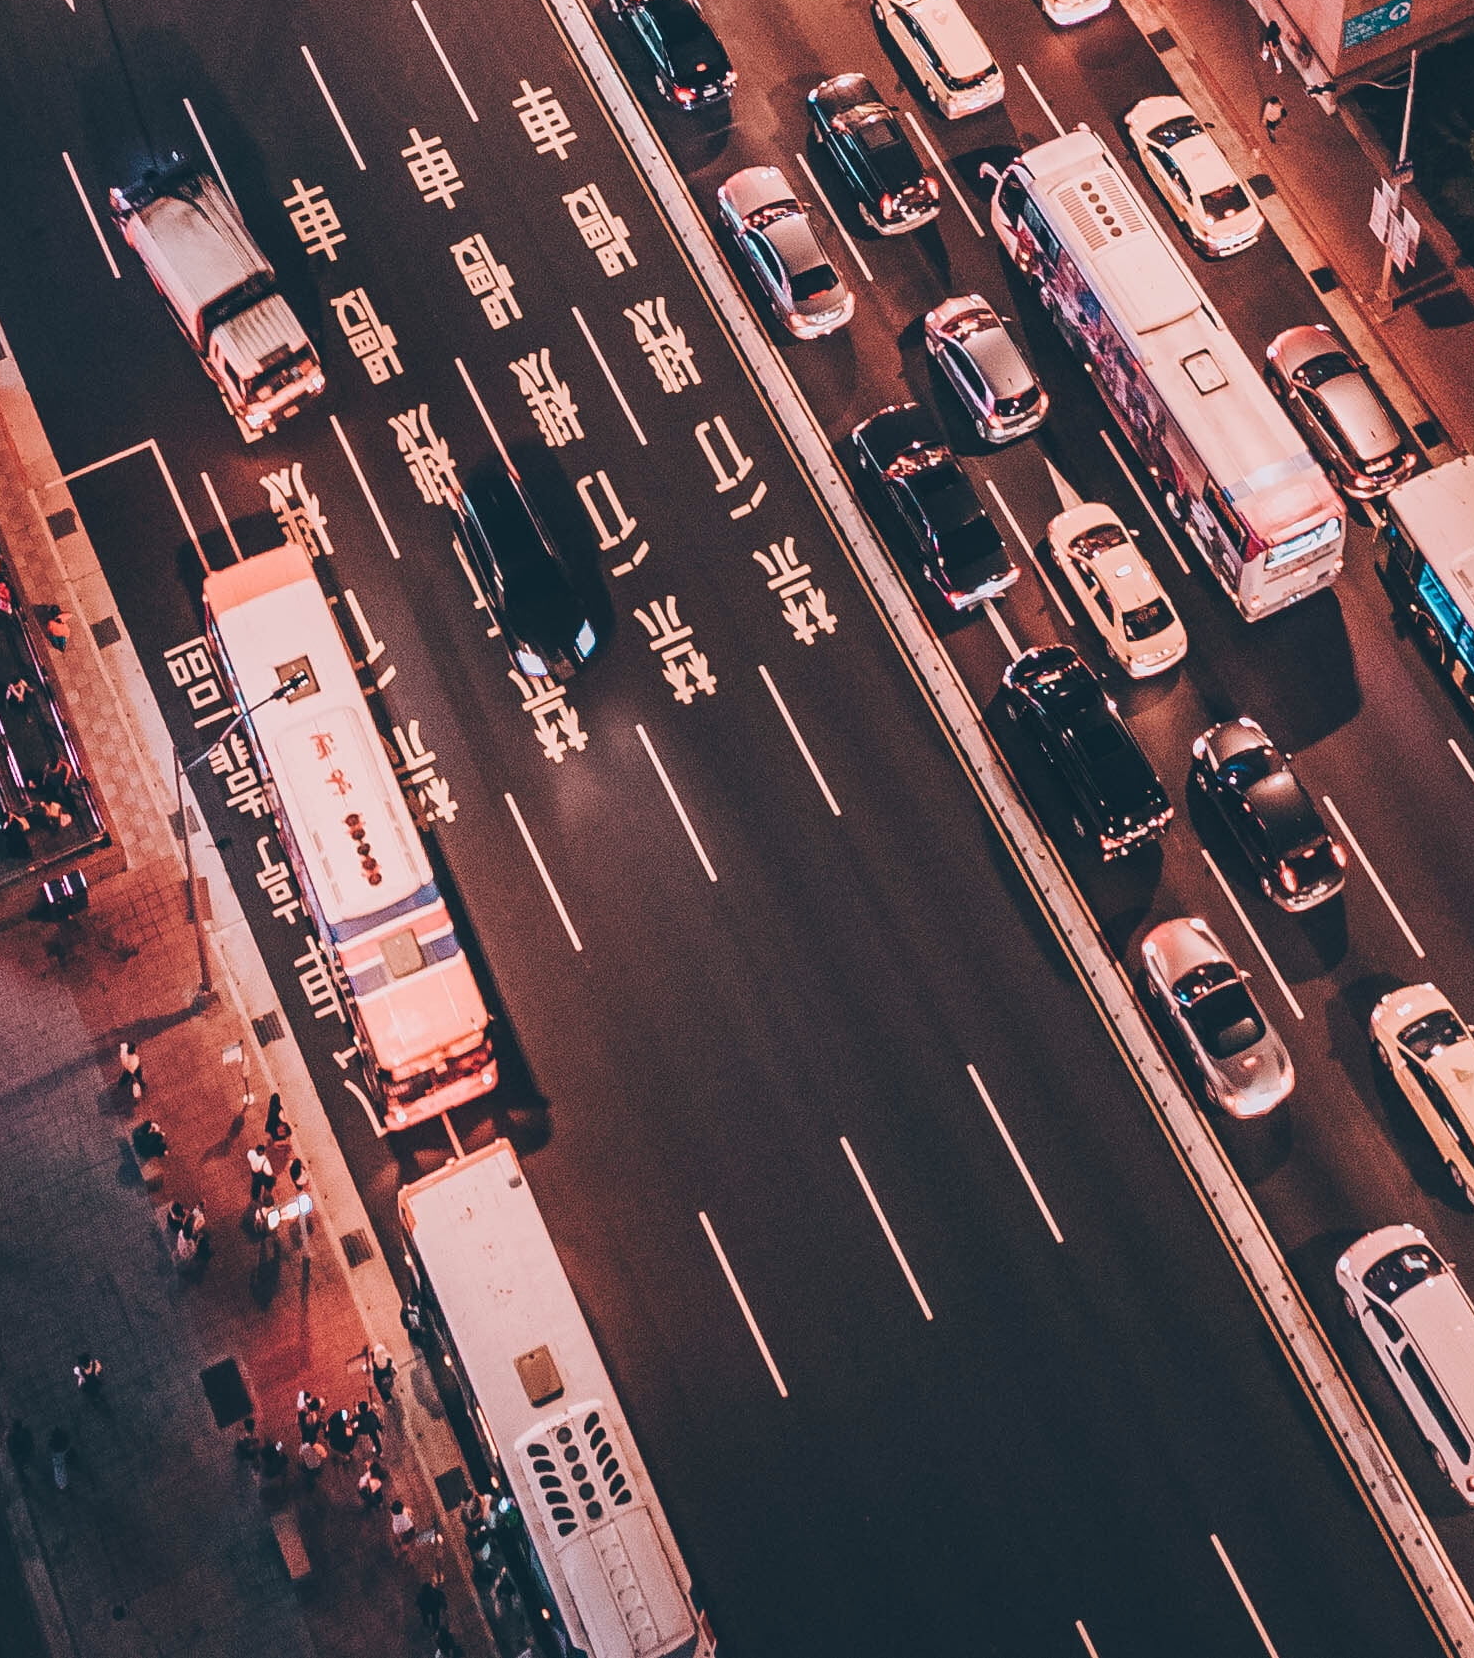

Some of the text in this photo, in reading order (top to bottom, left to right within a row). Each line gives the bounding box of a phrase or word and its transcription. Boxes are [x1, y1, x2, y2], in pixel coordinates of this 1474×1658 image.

[283, 178, 589, 764] 禁機慢車
[402, 127, 717, 704] 禁行機慢車
[512, 79, 839, 646] 禁行機慢車
